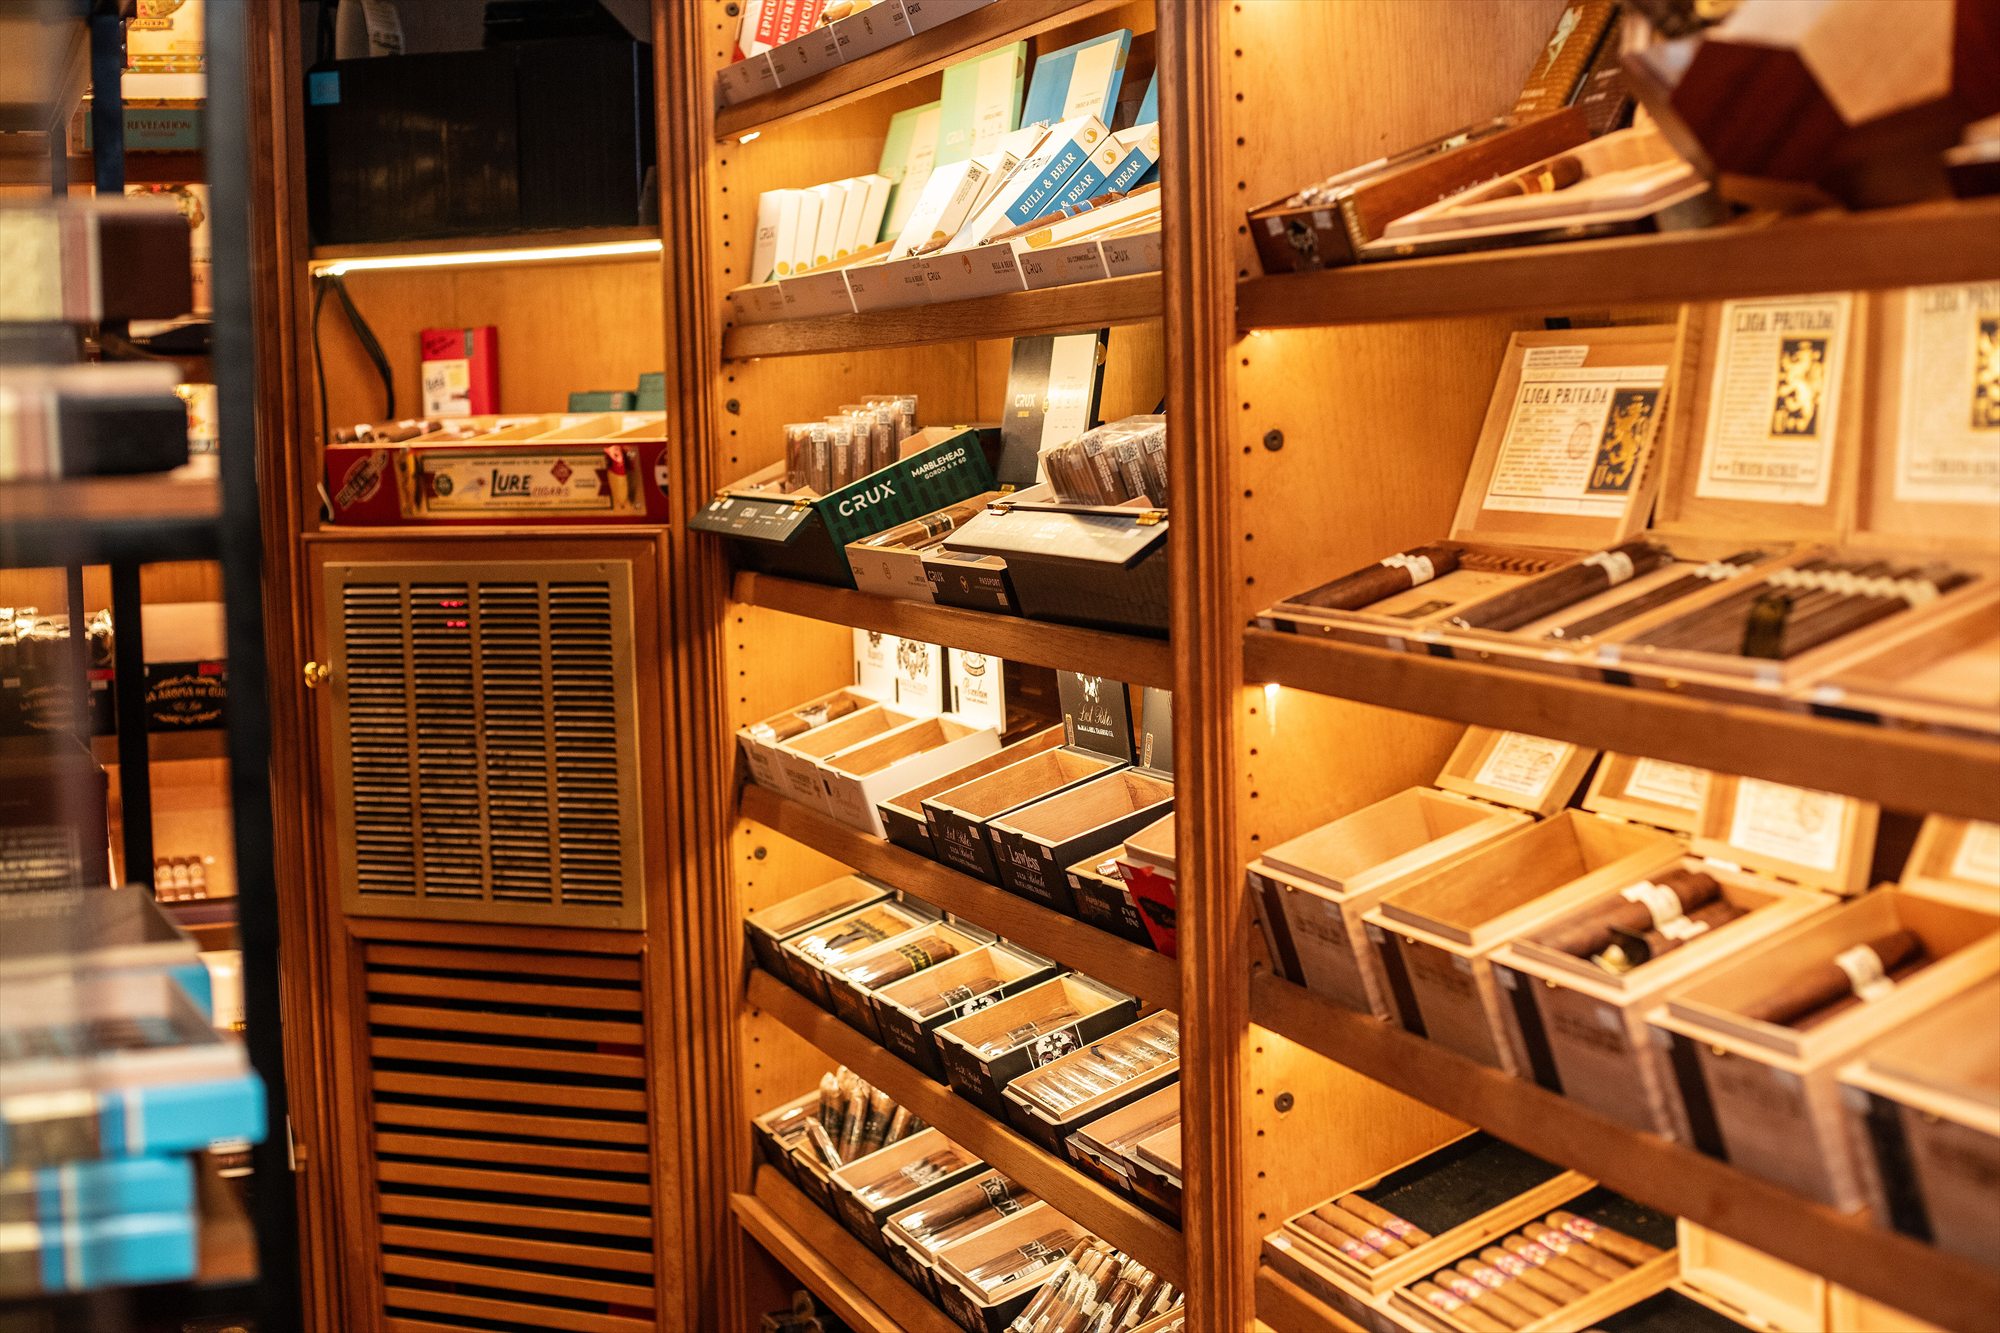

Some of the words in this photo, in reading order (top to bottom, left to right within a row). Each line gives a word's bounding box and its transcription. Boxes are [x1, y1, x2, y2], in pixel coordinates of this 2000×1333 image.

[1019, 187, 1045, 215] BULL
[1043, 178, 1053, 190] &
[1050, 152, 1077, 180] BEAR
[1115, 160, 1142, 188] BEAR
[1068, 173, 1095, 203] BEAR
[1109, 249, 1130, 264] CRUX
[927, 271, 942, 282] CRUX
[1025, 262, 1044, 276] CRUX
[1014, 393, 1036, 408] CRUX
[1523, 388, 1550, 404] LIGA
[1554, 387, 1609, 404] PRIVADA
[911, 447, 965, 478] MARBLEHEAD
[924, 466, 947, 480] GORDO
[952, 459, 958, 468] X
[491, 469, 532, 497] LURE
[838, 480, 897, 517] CRUX
[927, 570, 945, 583] CRUX
[158, 686, 193, 699] AROMA
[1007, 844, 1041, 872] Lawless
